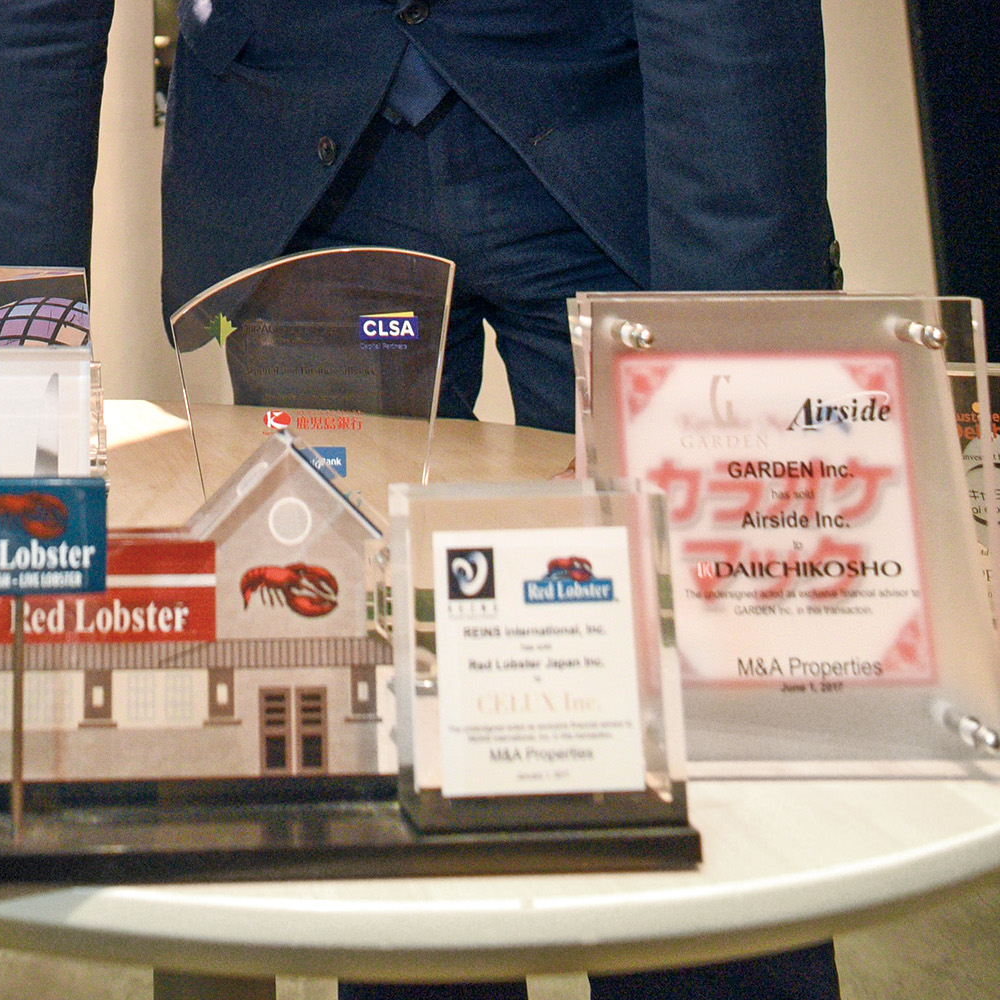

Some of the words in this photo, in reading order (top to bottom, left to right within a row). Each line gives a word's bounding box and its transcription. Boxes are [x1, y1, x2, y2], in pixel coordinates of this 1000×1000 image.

[363, 320, 415, 337] CLSA
[785, 397, 891, 432] Airside
[680, 434, 769, 449] GARDEN
[727, 461, 813, 479] GARDEN
[820, 461, 854, 479] Inc.
[741, 512, 810, 529] Airside
[815, 511, 851, 529] Inc.
[714, 560, 902, 579] DAIICHIKOSHO
[526, 582, 555, 600] Red
[557, 581, 610, 599] Lobster
[75, 598, 190, 634] Lobster
[737, 658, 783, 677] M&A
[788, 657, 884, 678] Properties
